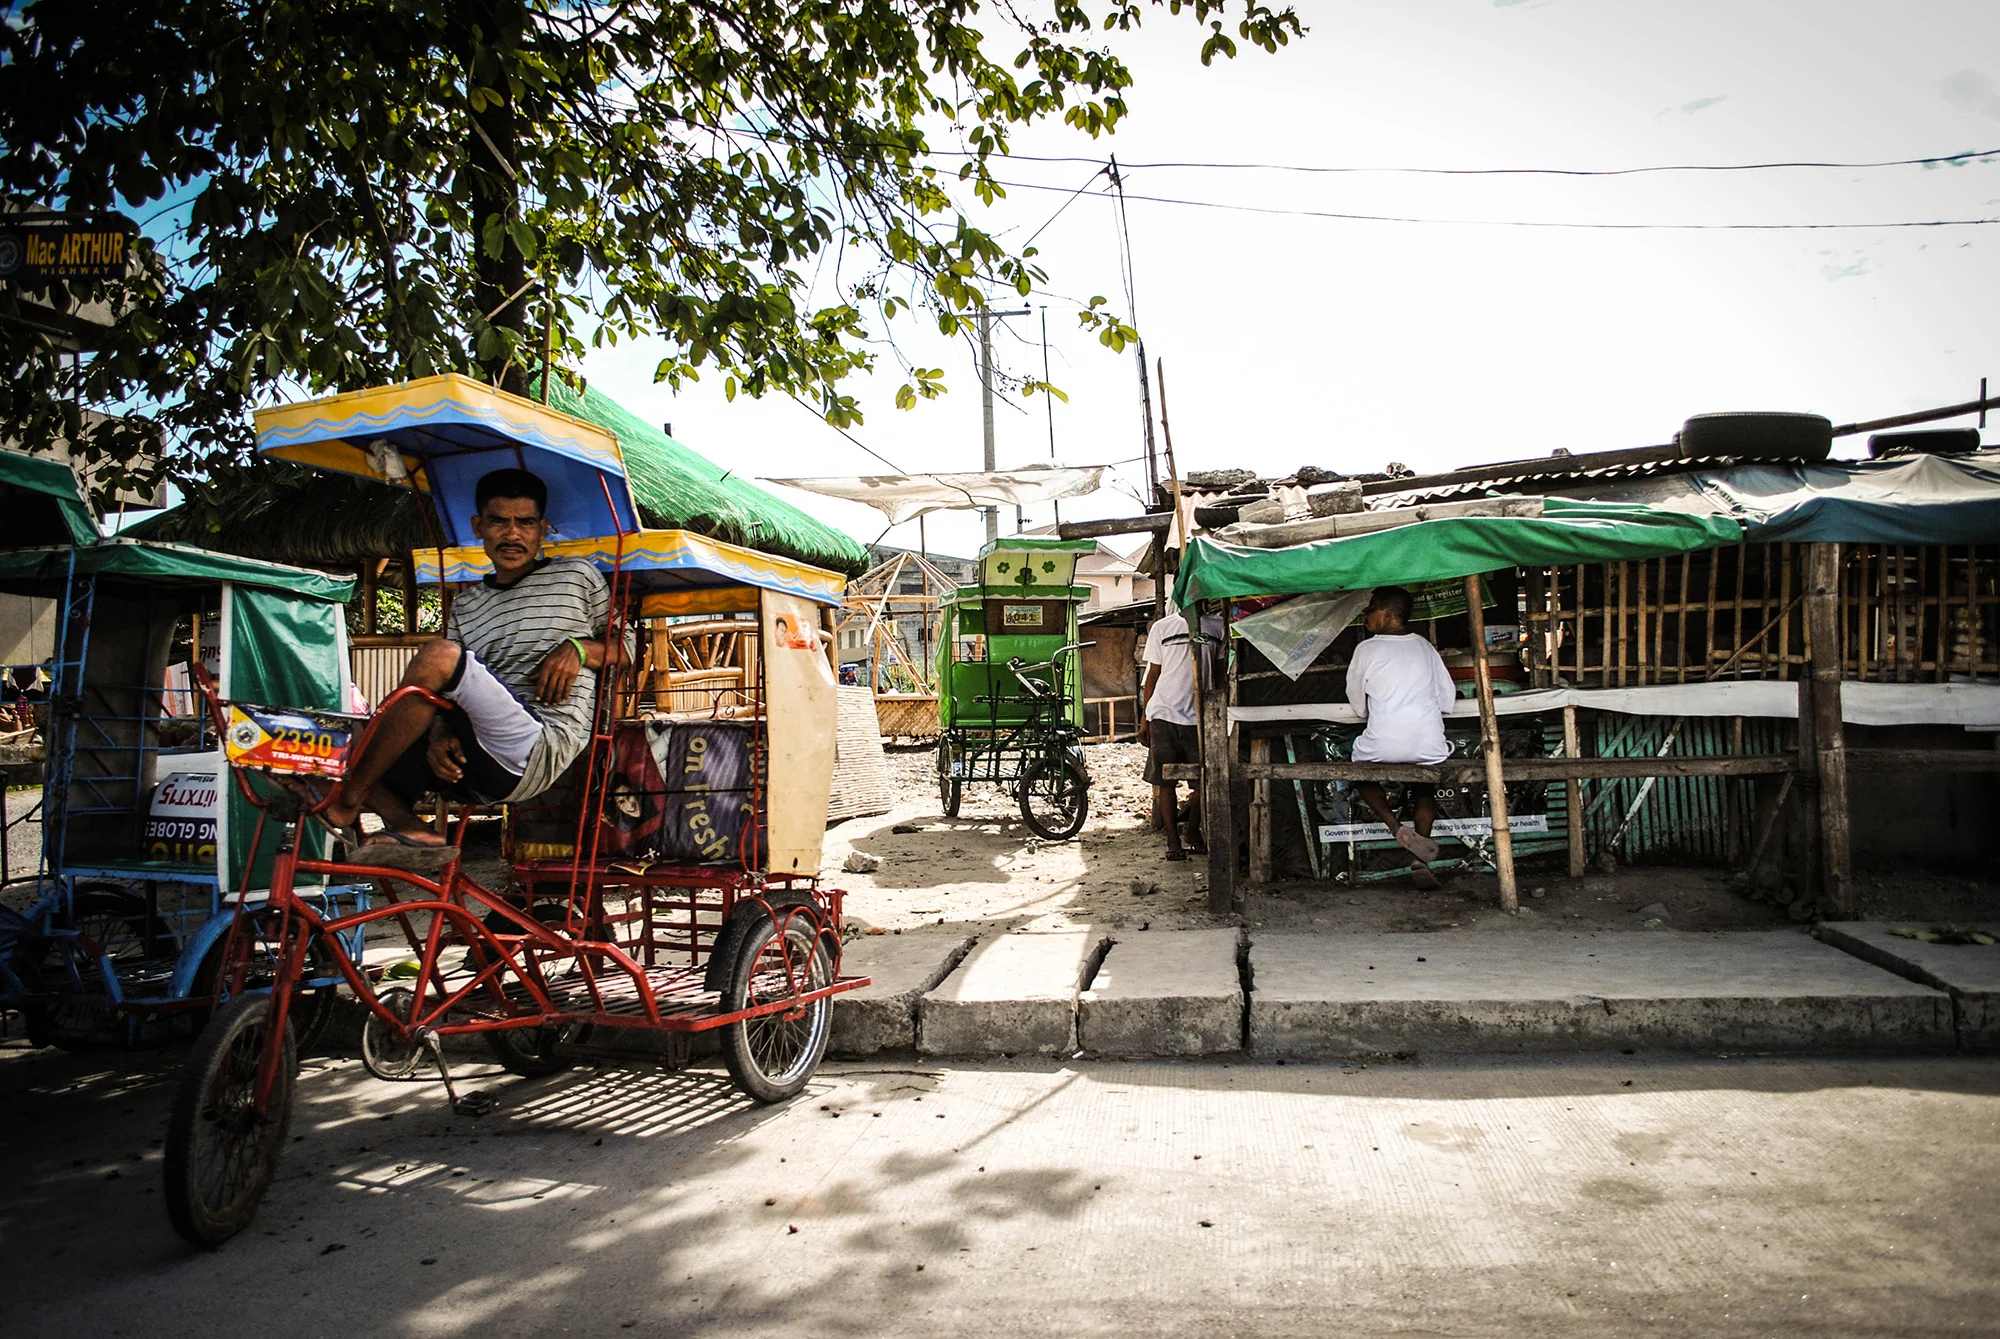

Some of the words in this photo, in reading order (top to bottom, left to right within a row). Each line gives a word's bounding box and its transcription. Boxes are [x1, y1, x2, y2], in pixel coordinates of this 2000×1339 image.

[26, 232, 57, 265] Mac
[59, 232, 124, 265] ARTHUR
[40, 266, 110, 276] HIGHWAY
[1434, 588, 1463, 600] register
[271, 727, 332, 757] 2330
[271, 751, 340, 766] TRI-WHEELER
[684, 737, 708, 773] on
[158, 784, 217, 807] liTXT15
[144, 821, 196, 839] GLOBE!
